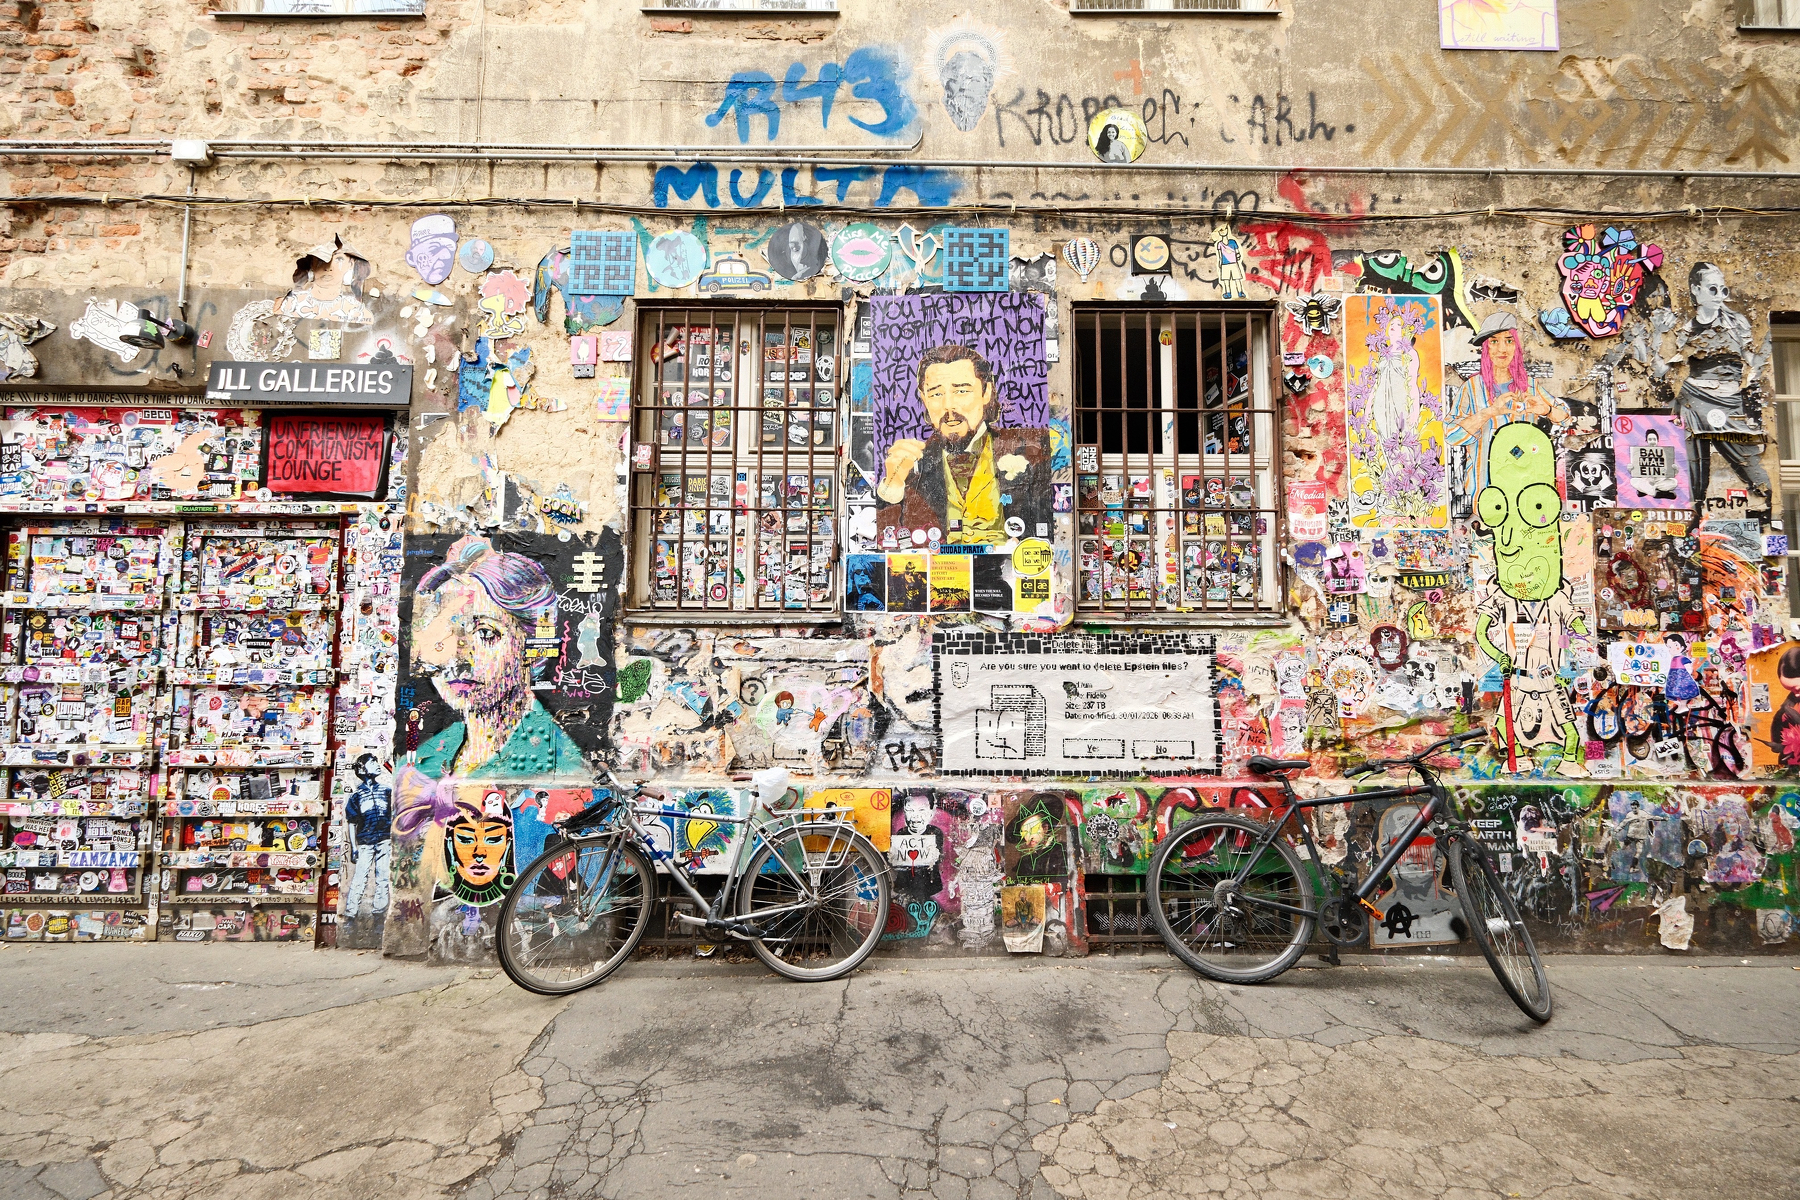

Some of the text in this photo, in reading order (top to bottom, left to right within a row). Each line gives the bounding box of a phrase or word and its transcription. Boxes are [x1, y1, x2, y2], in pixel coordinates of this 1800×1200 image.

[838, 228, 889, 250] Kiss Me
[840, 264, 880, 280] Place
[876, 294, 999, 322] YOU HAD MY
[954, 314, 1044, 336] BUT NOW
[881, 346, 918, 363] YOU
[985, 337, 1013, 358] MY
[698, 355, 722, 366] RÖEL
[1006, 358, 1048, 378] HAD
[217, 368, 394, 394] ILL GALLERIES
[882, 380, 1048, 402] MY BUT
[33, 393, 49, 402] IT'S
[52, 394, 72, 402] TIME
[74, 394, 85, 402] TO
[88, 394, 115, 404] DANCE
[134, 394, 149, 404] IT'S
[151, 394, 171, 404] TIME
[174, 395, 185, 404] TO
[1018, 402, 1046, 423] MY
[274, 420, 380, 440] UNFRIENDLY
[2, 444, 21, 454] TUPI
[272, 439, 380, 460] COMMUNISM
[1640, 448, 1664, 457] BAU
[1639, 458, 1664, 467] MAL
[272, 460, 343, 481] LOUNGE
[1640, 468, 1665, 476] EIN.
[540, 495, 582, 521] BOOM
[1647, 510, 1693, 521] PRIDE
[940, 546, 984, 554] CIUDAD PIRATA
[1330, 578, 1349, 587] FEEL
[1051, 640, 1080, 649] Delete
[980, 662, 996, 671] Are
[999, 664, 1015, 672] you
[1040, 664, 1057, 672] you
[1060, 663, 1080, 671] want
[1094, 662, 1121, 671] delete
[1124, 662, 1160, 673] Epstein
[1162, 662, 1188, 671] files?
[1155, 745, 1168, 754] No
[1469, 820, 1502, 828] KEEP
[900, 837, 926, 848] ACT
[69, 851, 138, 868] ZAMZAMZ
